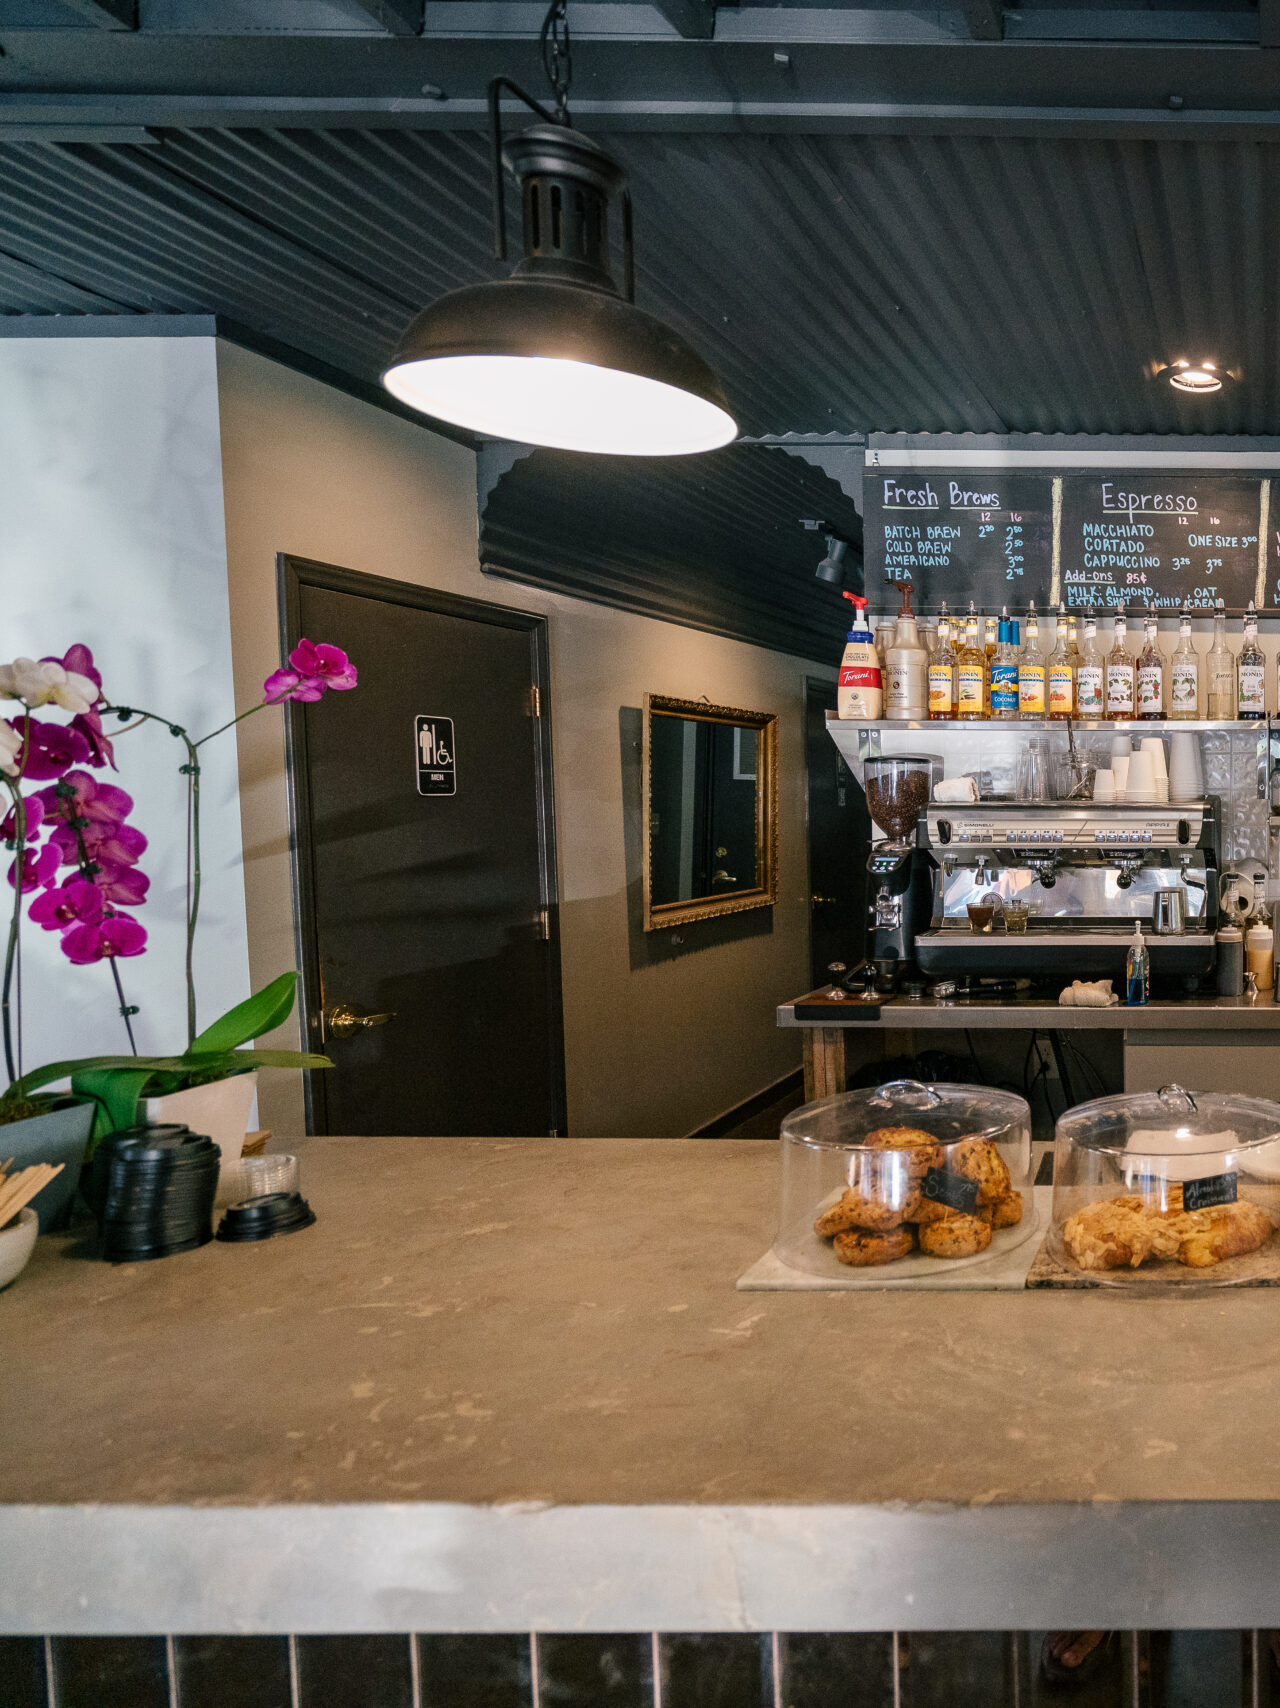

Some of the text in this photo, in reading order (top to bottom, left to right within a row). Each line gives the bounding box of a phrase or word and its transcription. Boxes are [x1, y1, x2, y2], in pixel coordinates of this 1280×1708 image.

[883, 479, 999, 506] Fresh Brews
[1102, 483, 1197, 524] Espresso
[981, 512, 1022, 522] 12 16
[1178, 517, 1188, 525] 12
[885, 526, 920, 538] BATCH
[928, 526, 960, 538] BREW
[1083, 523, 1154, 537] MACCHIATO
[886, 541, 913, 553] COLD
[917, 542, 951, 553] BREW
[1084, 538, 1144, 552] CORTADO
[1188, 535, 1212, 547] ONE
[1215, 536, 1238, 547] SIZE
[885, 555, 949, 566] AMERICANO
[1084, 554, 1160, 568] CAPPUCCINO
[885, 568, 912, 579] TEA
[1068, 586, 1102, 597] MILK:
[1194, 587, 1217, 597] OAT
[1068, 596, 1105, 607] EXTRA
[1107, 597, 1131, 605] SHOT
[1154, 598, 1181, 607] WHIP
[1188, 599, 1224, 608] CREAM
[843, 671, 869, 684] Torani
[992, 669, 1016, 684] Torani
